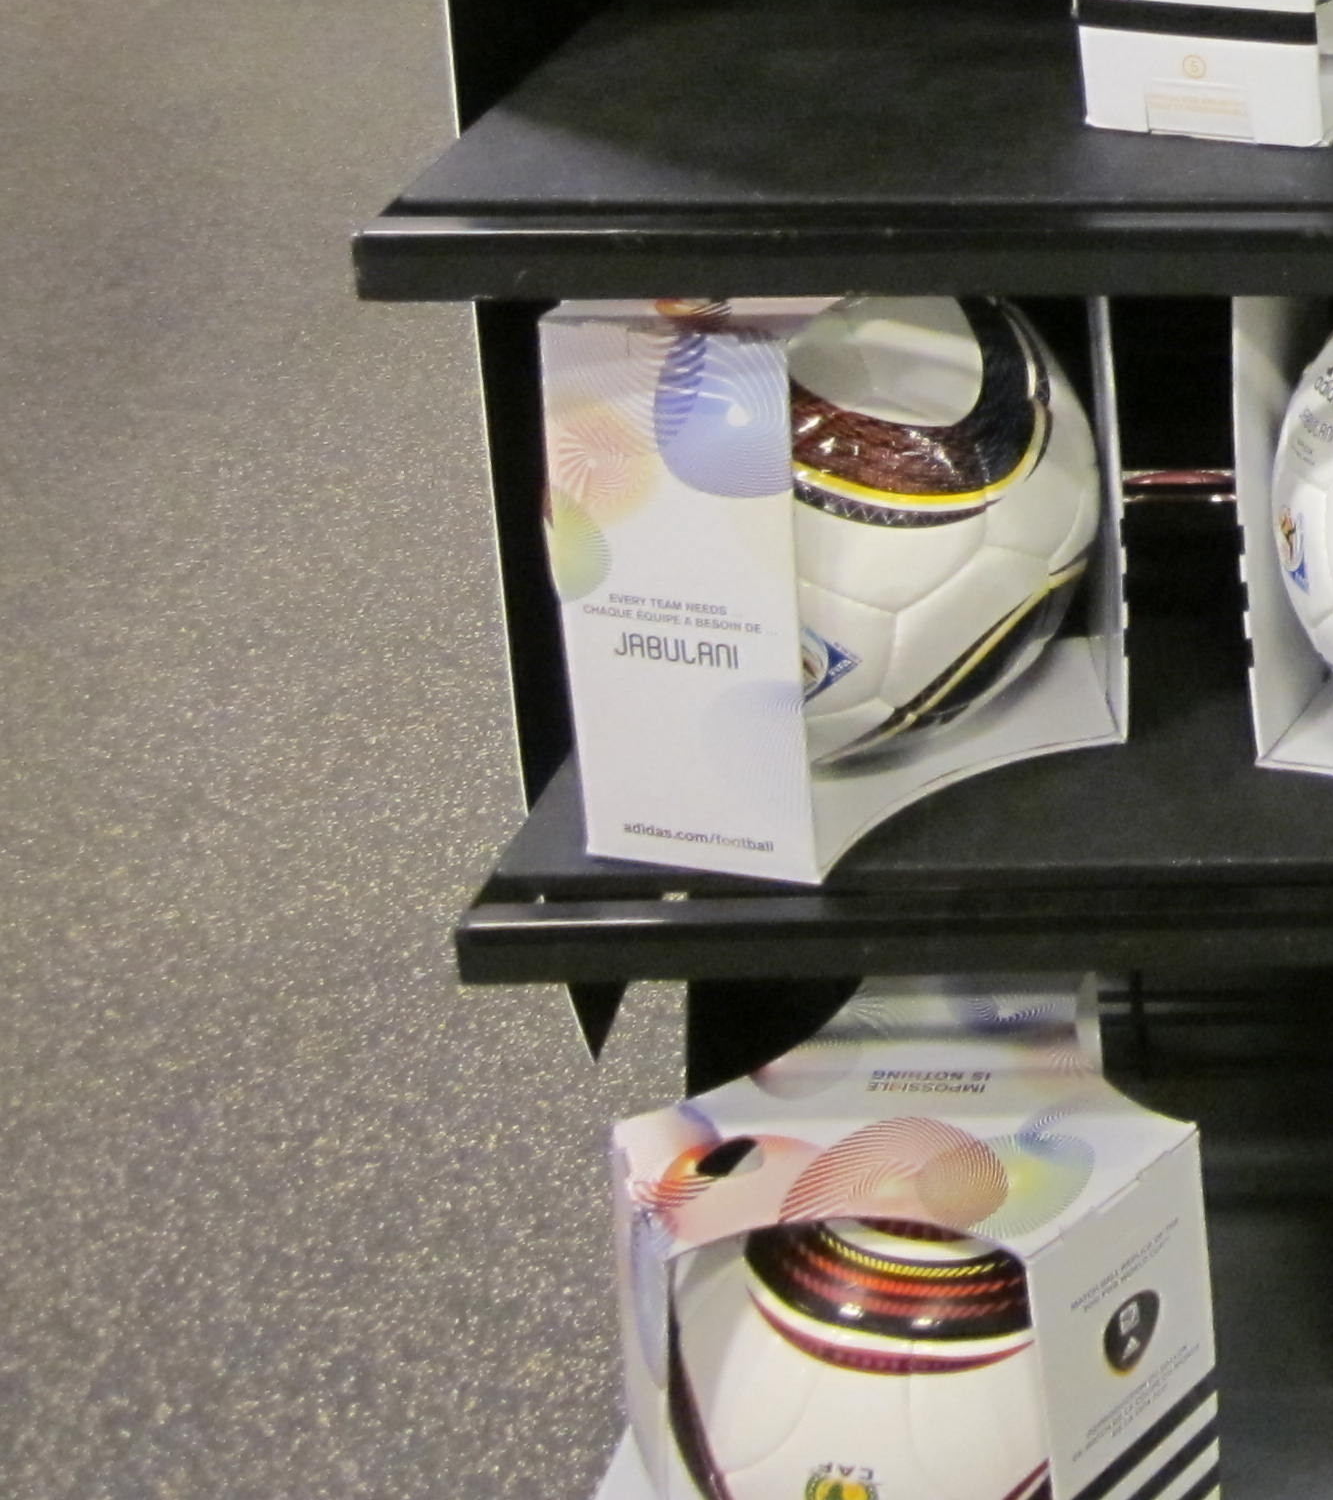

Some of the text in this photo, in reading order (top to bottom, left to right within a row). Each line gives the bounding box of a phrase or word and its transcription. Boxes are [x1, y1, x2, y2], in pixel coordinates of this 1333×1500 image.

[581, 603, 633, 619] CHAQUE
[694, 616, 742, 632] BESOIN
[743, 621, 762, 634] DE
[607, 592, 728, 617] EVERY TEAM NEEDS
[613, 631, 740, 671] JABULANI
[622, 823, 774, 852] adidas.com/football
